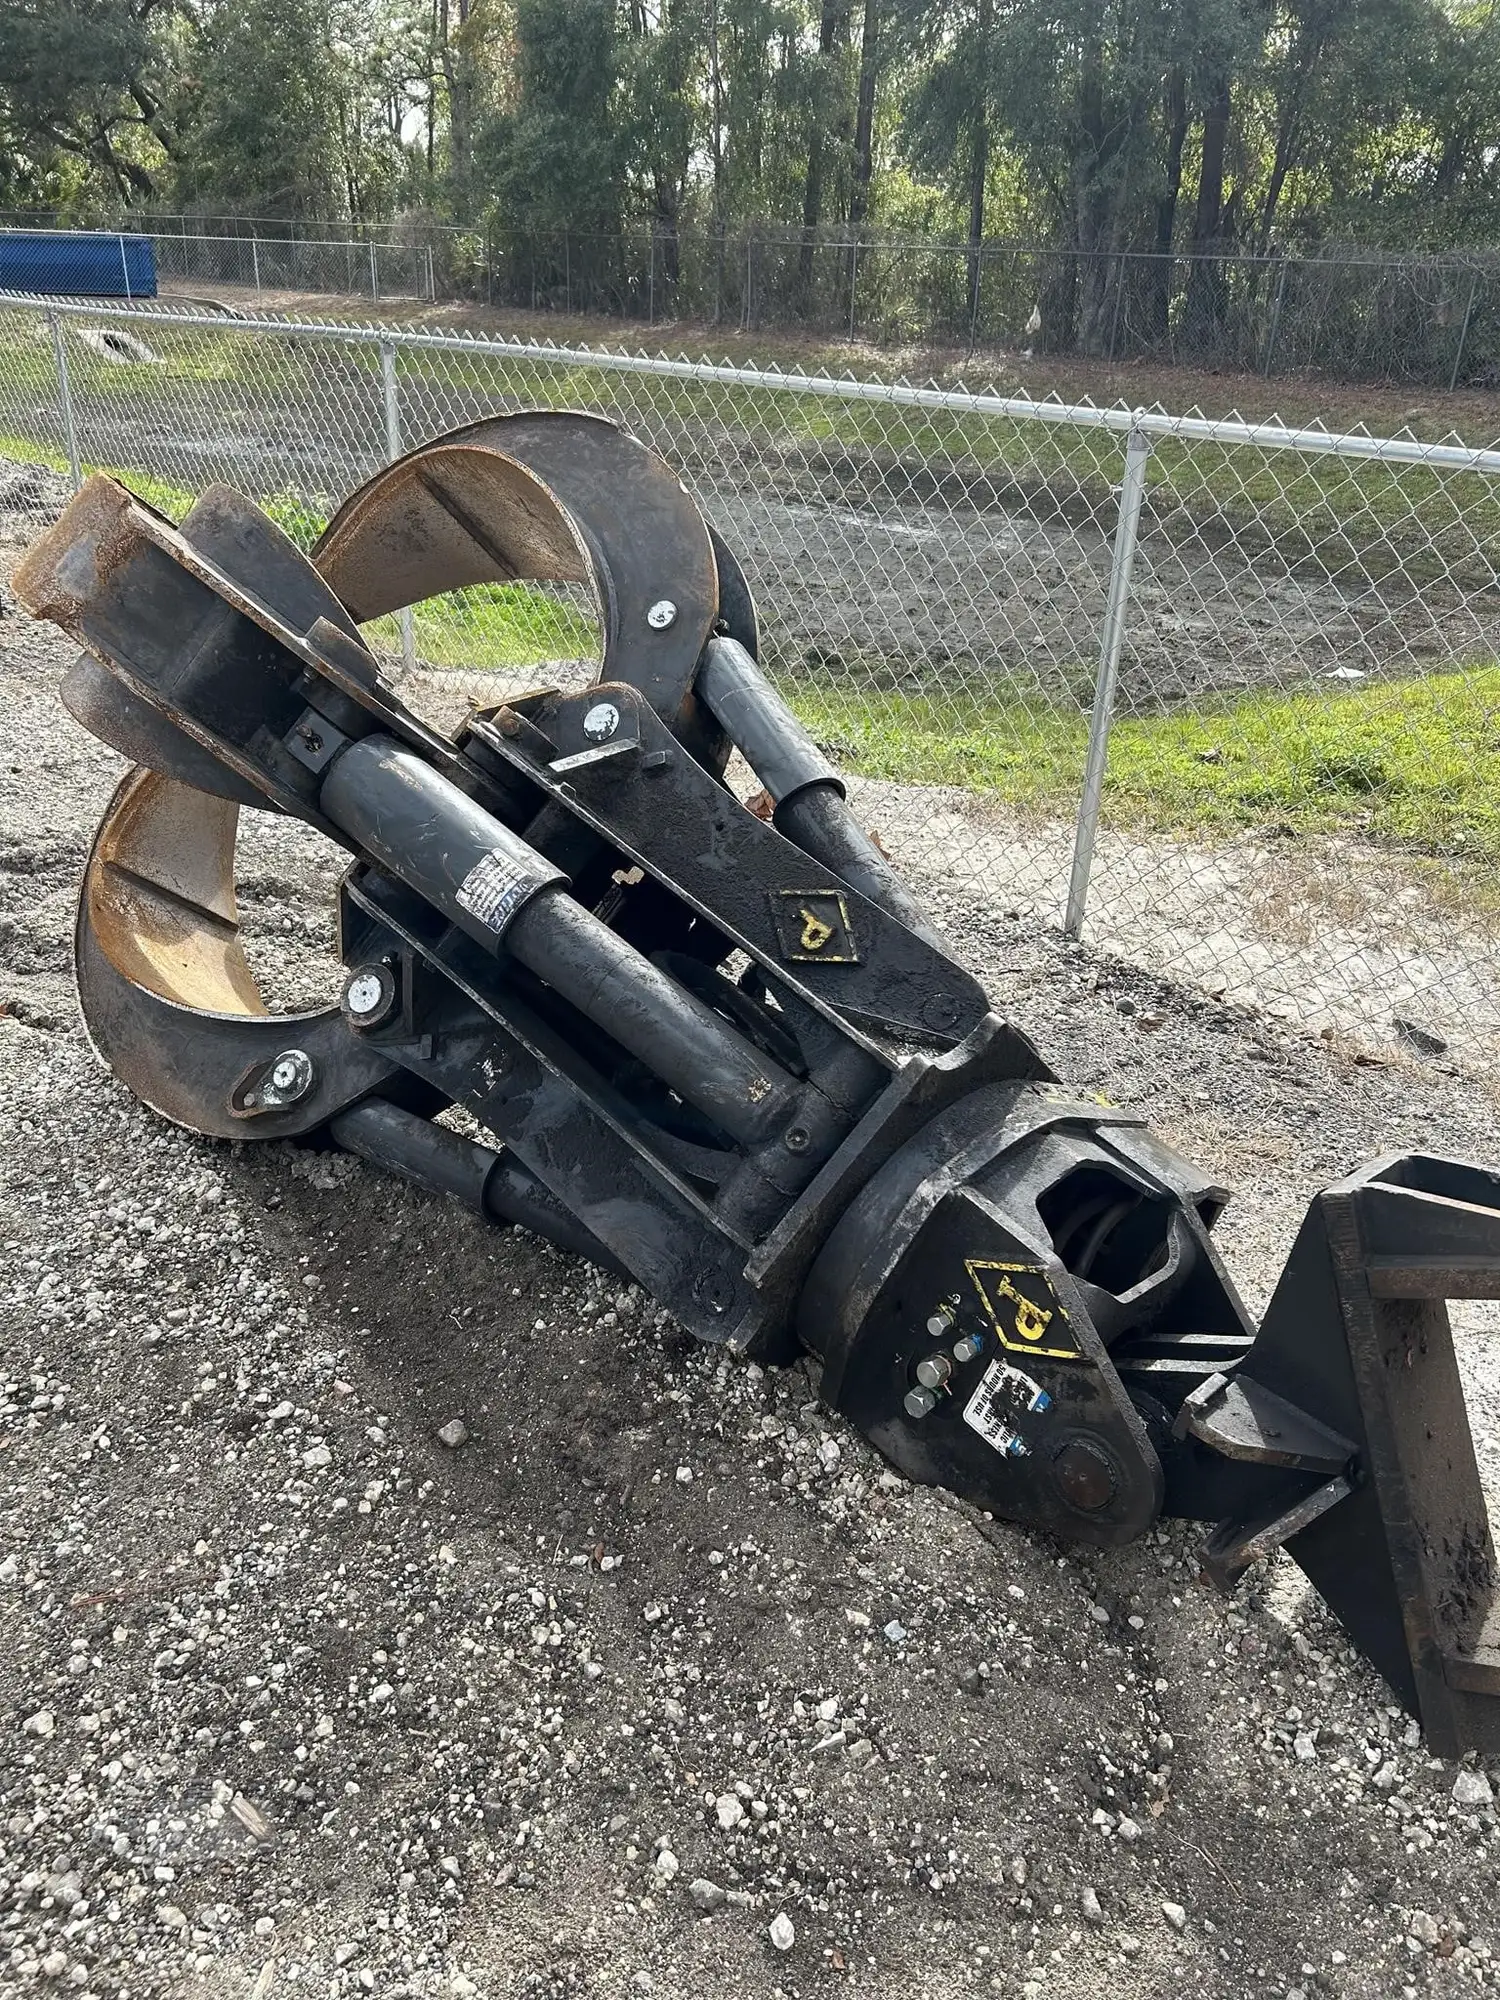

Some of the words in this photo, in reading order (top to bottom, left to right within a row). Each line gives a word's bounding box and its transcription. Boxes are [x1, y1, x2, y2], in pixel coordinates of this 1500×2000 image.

[995, 1364, 1006, 1376] 50
[984, 1373, 1000, 1396] HOURS
[979, 1394, 989, 1404] OF
